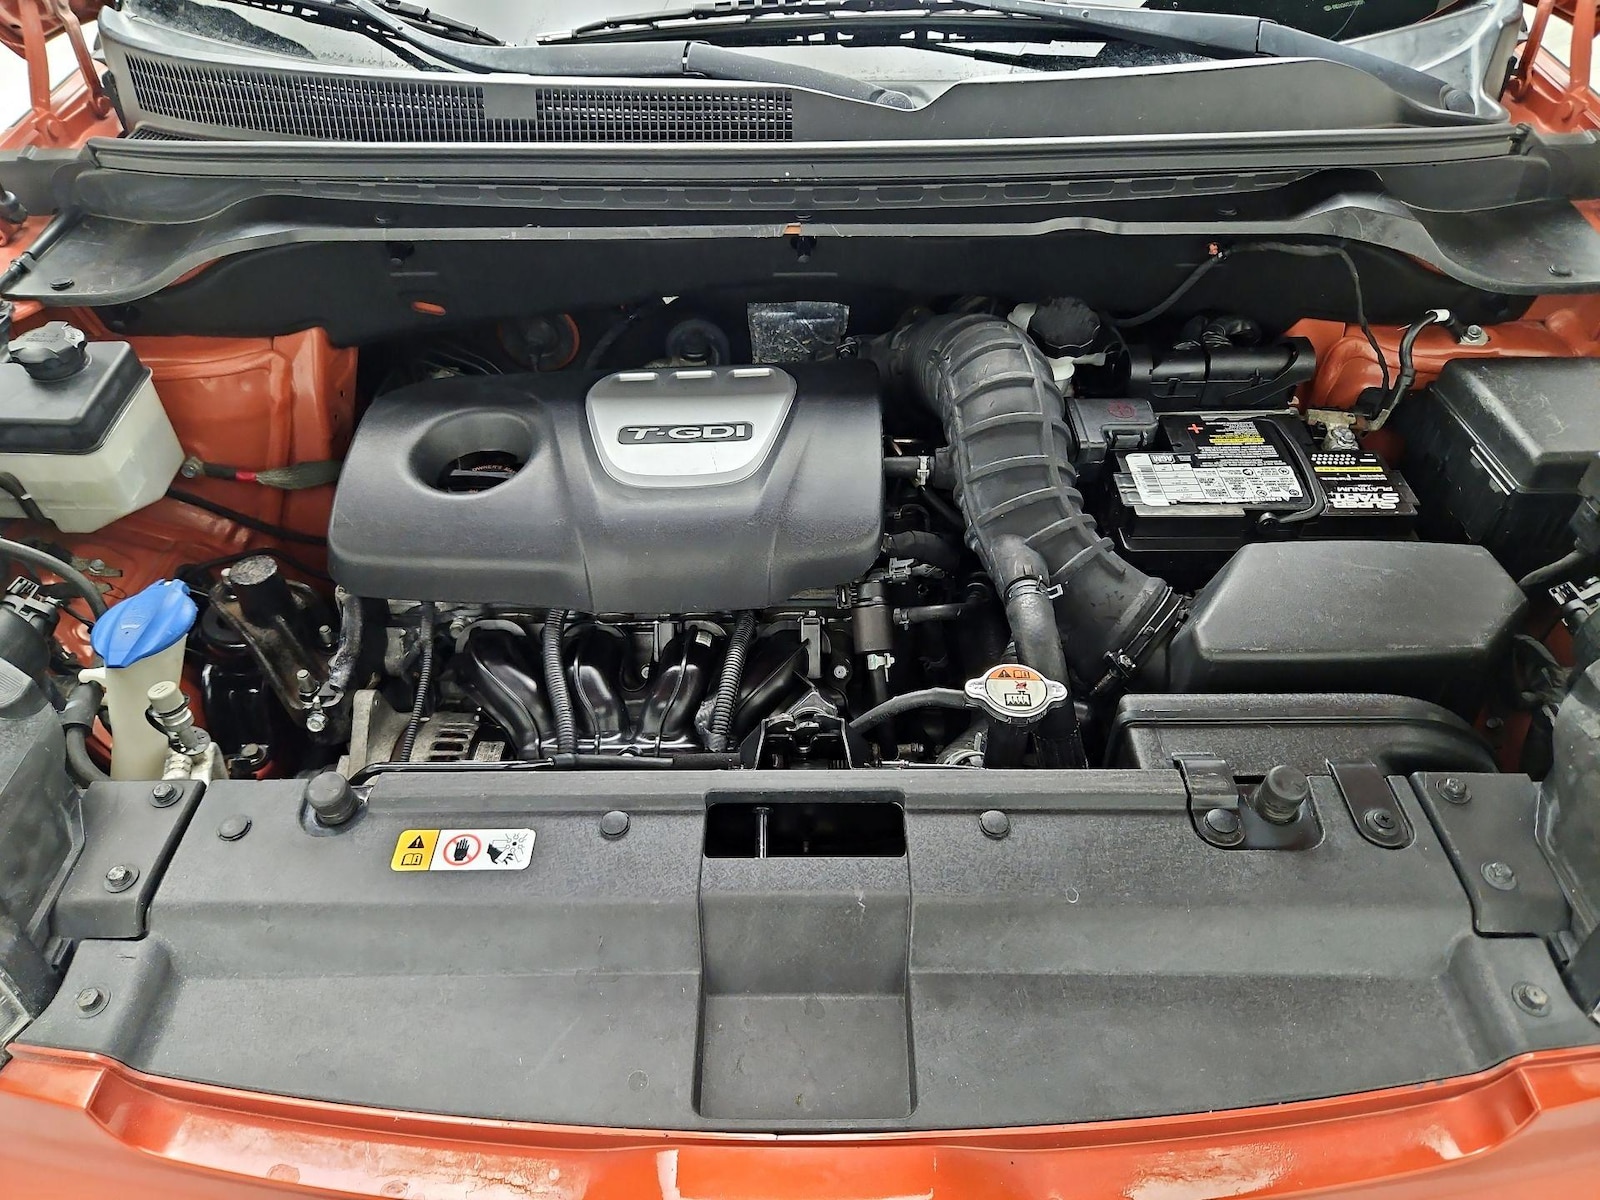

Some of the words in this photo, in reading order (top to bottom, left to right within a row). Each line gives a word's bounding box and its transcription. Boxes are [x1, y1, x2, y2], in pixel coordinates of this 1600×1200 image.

[627, 424, 746, 441] T-GDI
[1328, 492, 1401, 504] START
[1333, 500, 1397, 510] SUPER
